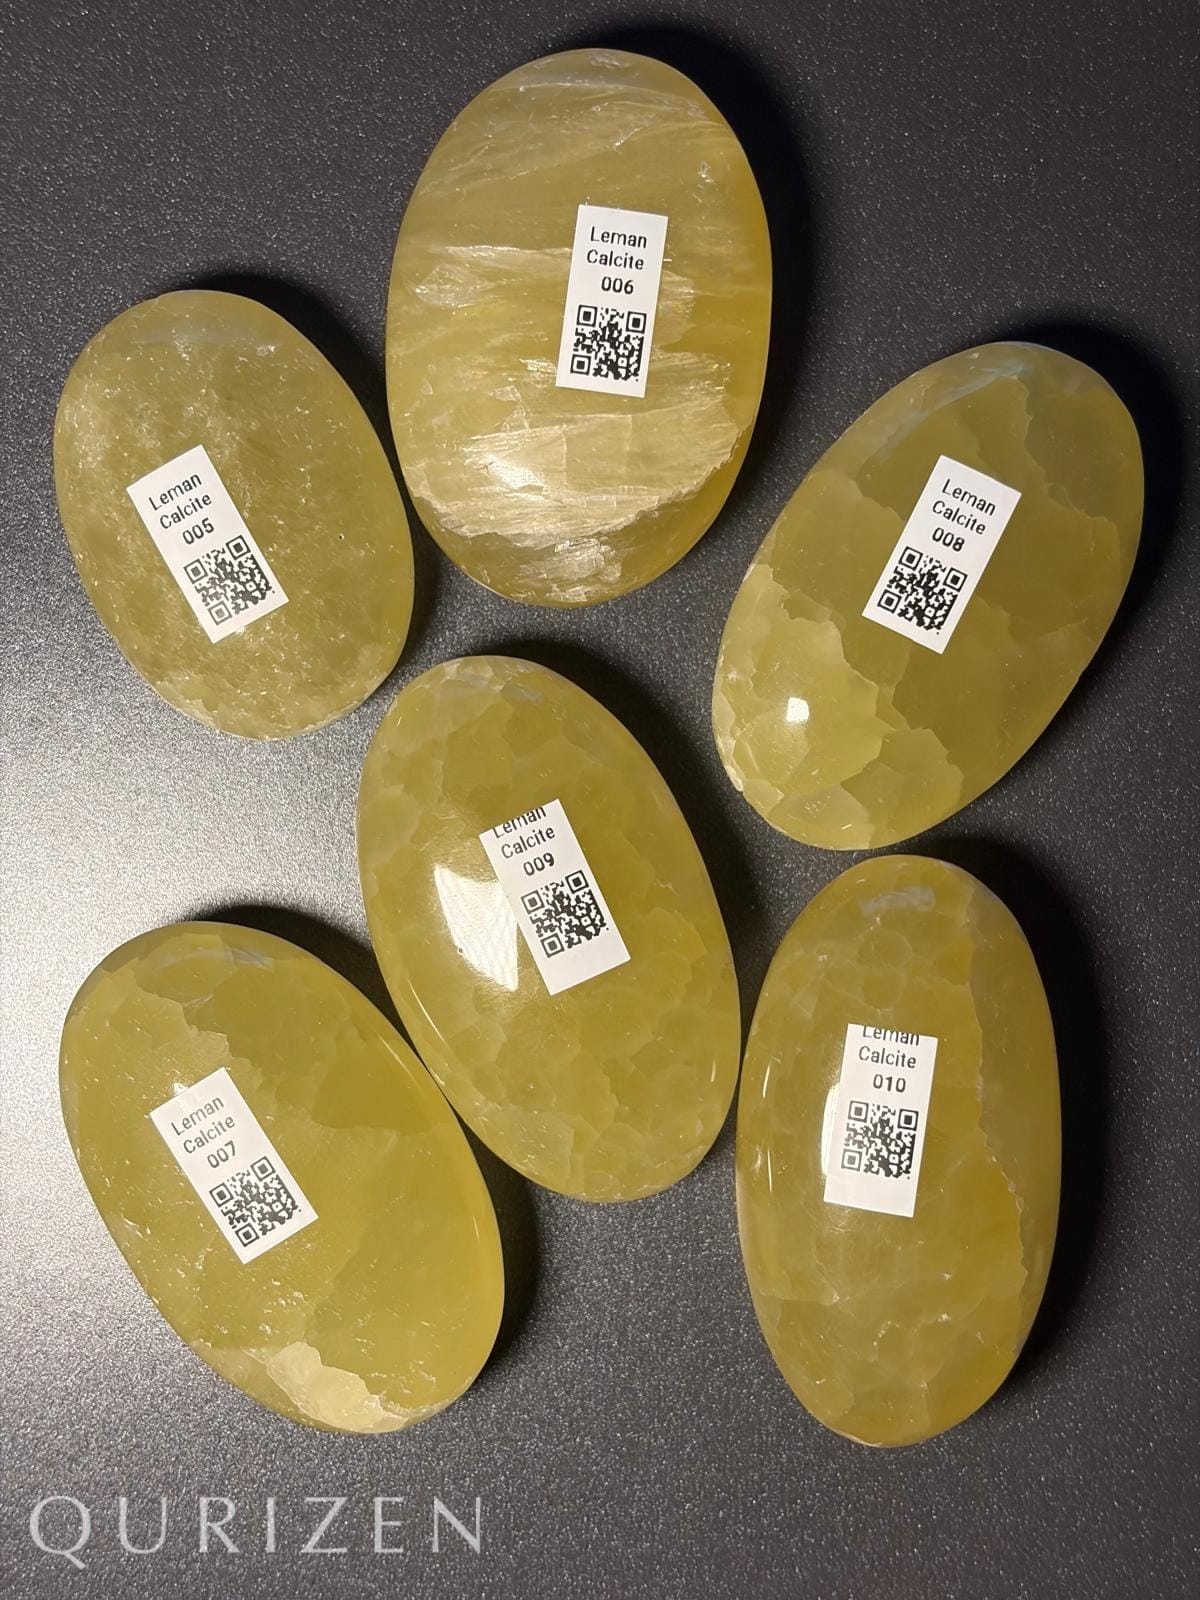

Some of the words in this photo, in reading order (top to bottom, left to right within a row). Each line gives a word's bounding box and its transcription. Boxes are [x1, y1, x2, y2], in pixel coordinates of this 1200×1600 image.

[590, 226, 647, 249] Leman
[586, 249, 645, 270] Calcite
[601, 276, 634, 295] 006
[148, 474, 202, 511] Leman
[942, 478, 996, 516] Leman
[160, 494, 212, 529] Calcite
[932, 500, 986, 535] Calcite
[182, 517, 215, 545] 005
[932, 527, 965, 552] 008
[493, 806, 547, 839] Leman
[501, 827, 556, 859] Calcite
[523, 852, 554, 877] 009
[862, 1025, 920, 1046] Leman
[858, 1045, 917, 1069] Calcite
[873, 1073, 906, 1093] 010
[171, 1097, 224, 1136] Leman
[183, 1116, 235, 1154] Calcite
[207, 1140, 235, 1169] 007
